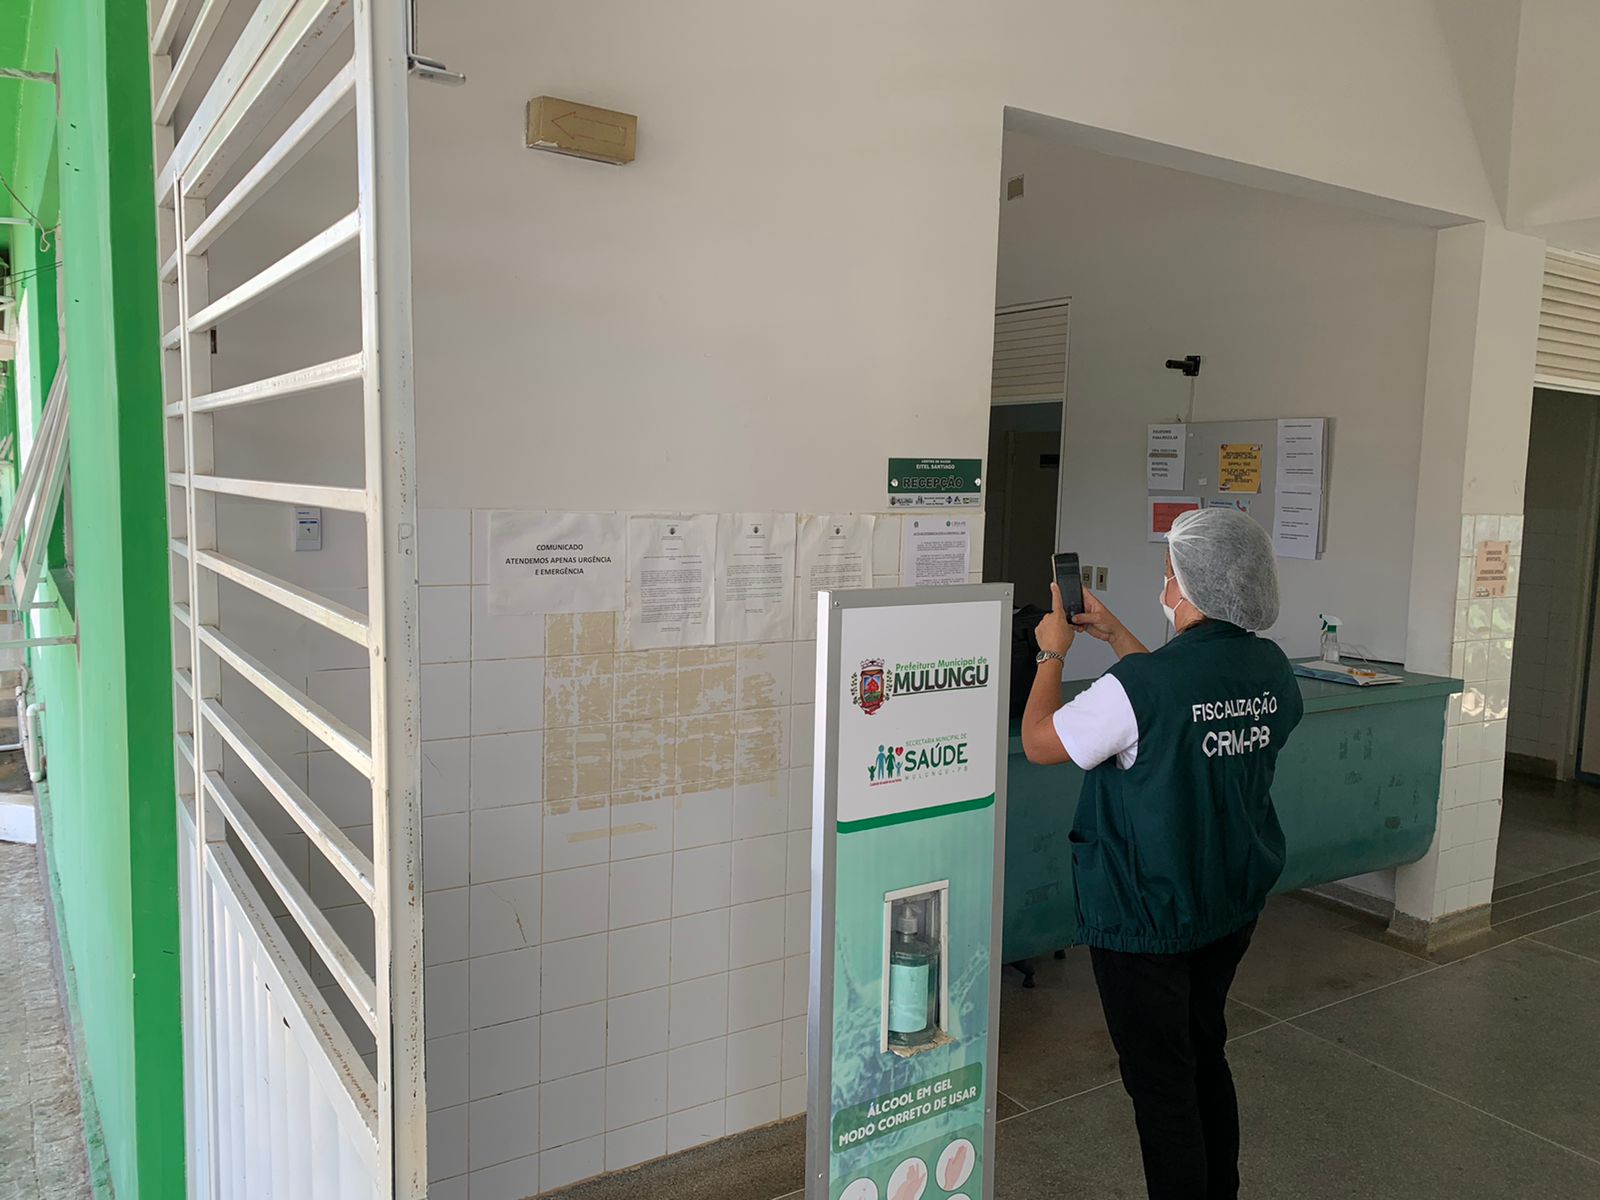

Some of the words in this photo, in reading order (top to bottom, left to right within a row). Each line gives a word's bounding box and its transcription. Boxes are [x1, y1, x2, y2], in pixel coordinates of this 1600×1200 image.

[902, 475, 964, 491] RECEPÇÃO
[505, 557, 549, 565] ATENDEMOS
[550, 556, 577, 564] APENAS
[578, 555, 612, 563] URGÊNCIA
[536, 543, 584, 551] COMUNICADO
[535, 568, 540, 576] E
[540, 567, 584, 575] EMERGÊNCIA
[893, 664, 989, 694] MULUNGU
[895, 661, 936, 672] Prefeitura
[937, 657, 976, 669] Municipal
[977, 656, 987, 664] de
[1191, 691, 1278, 723] FISCALIZAÇÃO
[1201, 725, 1271, 758] CRM-PB
[904, 742, 969, 772] SAÚDE
[867, 1092, 914, 1118] ÁLCOOL
[916, 1085, 932, 1101] EM
[933, 1078, 953, 1094] GEL
[838, 1122, 876, 1147] MODO
[878, 1102, 932, 1131] CORRETO
[933, 1098, 947, 1111] DE
[949, 1086, 977, 1105] USAR
